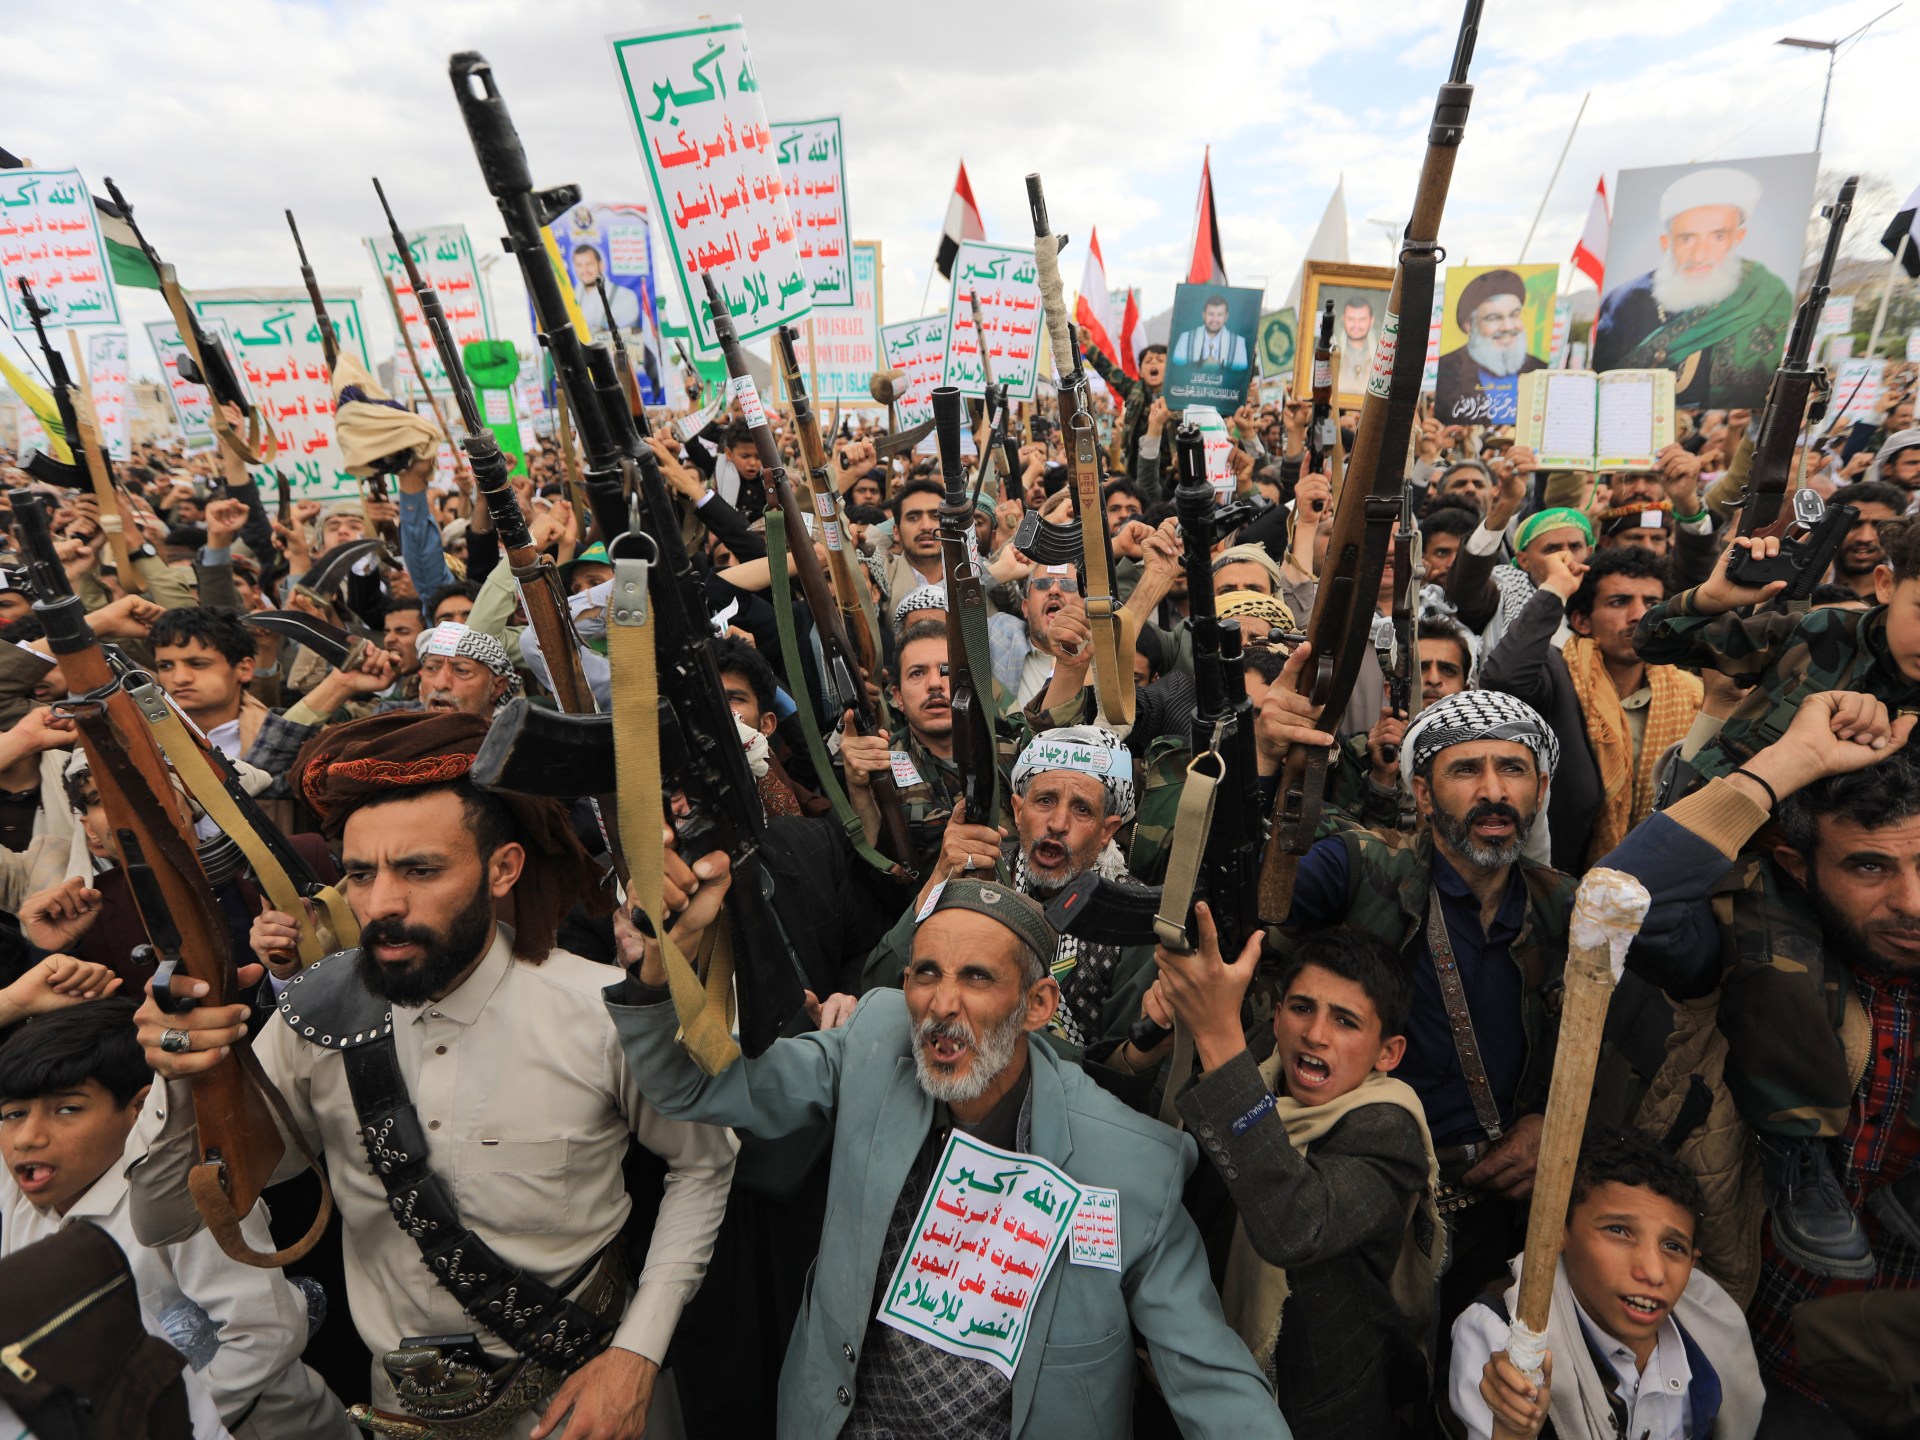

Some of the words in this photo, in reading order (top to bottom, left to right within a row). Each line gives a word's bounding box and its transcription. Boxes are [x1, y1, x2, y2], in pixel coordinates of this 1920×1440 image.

[644, 38, 726, 127] أكبر
[654, 112, 738, 170] لأمريكا
[777, 128, 803, 164] أك
[807, 130, 837, 162] الله
[0, 176, 41, 217] أكب
[48, 180, 85, 205] الله
[804, 173, 840, 200] الموت
[674, 173, 750, 230] لإسرائيل
[47, 213, 92, 235] الموت
[807, 206, 843, 231] الموت
[53, 240, 98, 261] الموت
[436, 235, 468, 261] الله
[686, 229, 742, 273] اليهود
[747, 223, 771, 262] على
[817, 237, 845, 258] اللعنة
[69, 265, 103, 283] اللعنة
[811, 264, 847, 299] النصر
[960, 253, 1012, 285] أكبر
[1012, 260, 1037, 284] لله
[65, 288, 109, 318] النصر
[1004, 292, 1040, 311] الموت
[233, 305, 295, 358] أكب
[831, 317, 864, 336] ISRAEL
[1001, 319, 1037, 337] الموت
[890, 325, 921, 356] أكبر
[1007, 341, 1034, 360] اللعنة
[302, 428, 329, 455] على
[1247, 1099, 1268, 1120] CANALI
[945, 1164, 1029, 1198] أكبر
[935, 1188, 1003, 1226] لأمريكا
[1022, 1179, 1069, 1223] الله
[1083, 1193, 1099, 1207] أك
[1099, 1196, 1115, 1208] الله
[1074, 1221, 1096, 1232] لإسرائيل
[1097, 1213, 1116, 1222] الموت
[1097, 1226, 1116, 1235] الموت
[922, 1221, 991, 1262] لإسرائيل
[1003, 1214, 1052, 1255] الموت
[1075, 1234, 1090, 1243] اليهود
[1092, 1237, 1101, 1245] على
[1102, 1237, 1117, 1246] اللعنة
[1075, 1244, 1097, 1259] للإسلام
[1099, 1247, 1117, 1259] النصر
[911, 1251, 961, 1281] اليهود
[990, 1247, 1041, 1285] الموت
[958, 1271, 987, 1296] على
[990, 1279, 1029, 1313] اللعنة
[895, 1277, 964, 1327] للإسلام
[959, 1311, 1021, 1345] النصر
